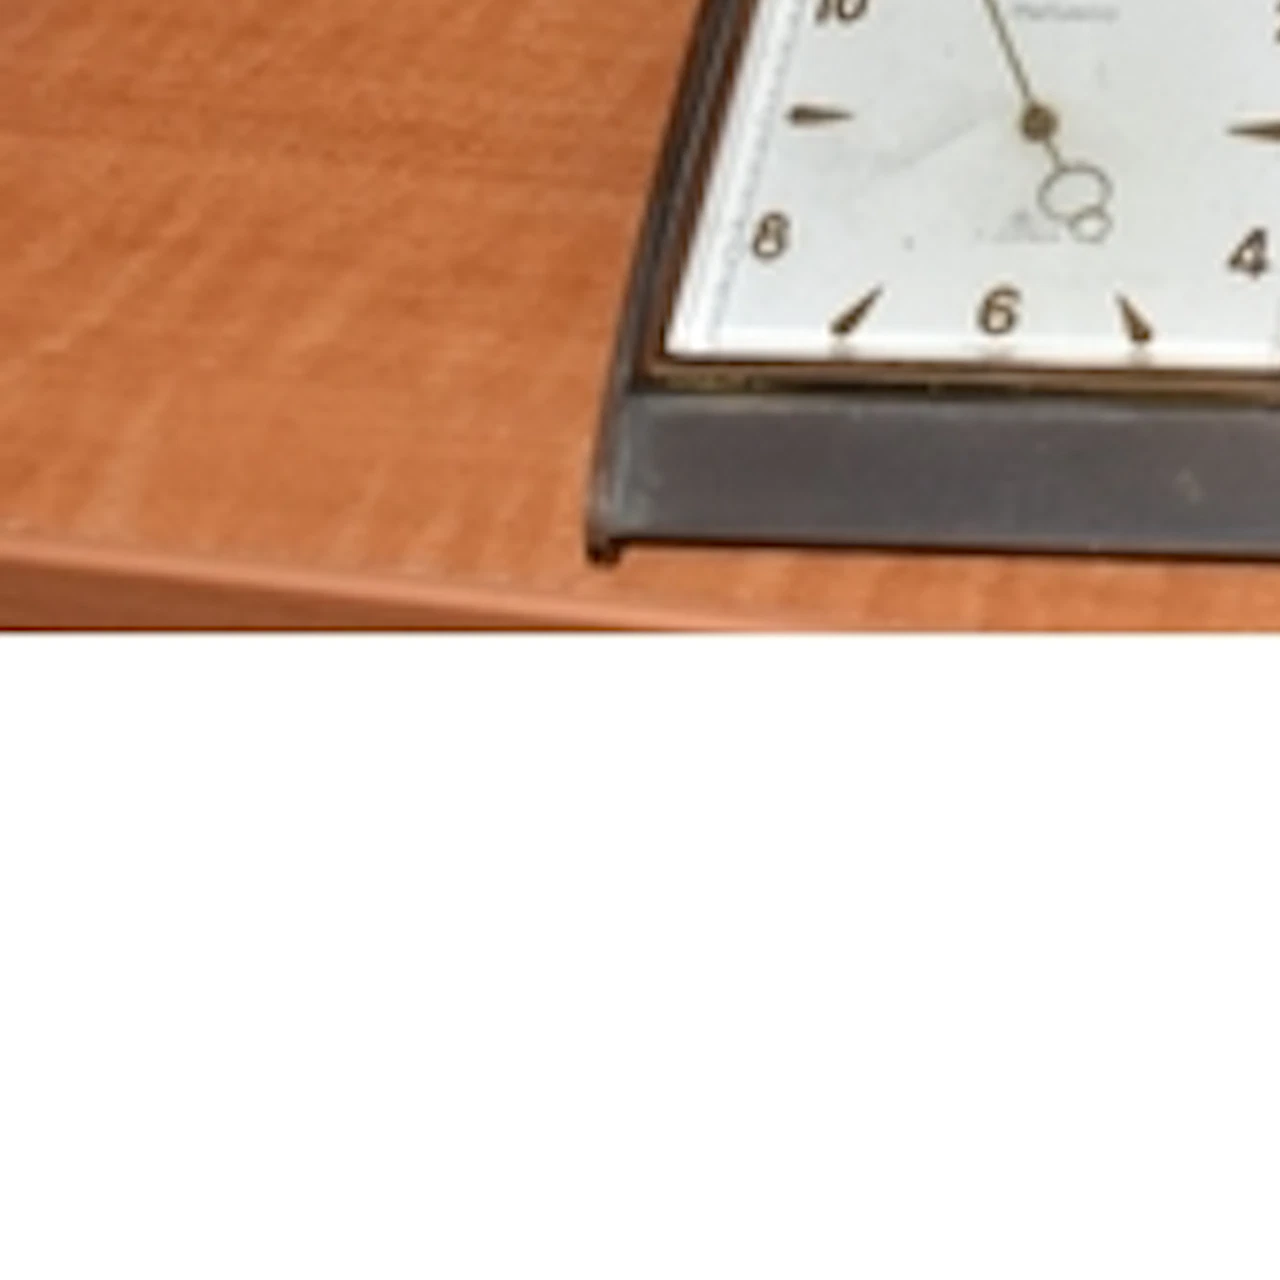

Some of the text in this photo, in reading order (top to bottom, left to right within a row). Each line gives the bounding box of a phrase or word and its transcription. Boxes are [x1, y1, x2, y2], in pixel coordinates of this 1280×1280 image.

[751, 211, 790, 260] 8
[1227, 226, 1271, 278] 4
[977, 286, 1022, 335] 6
